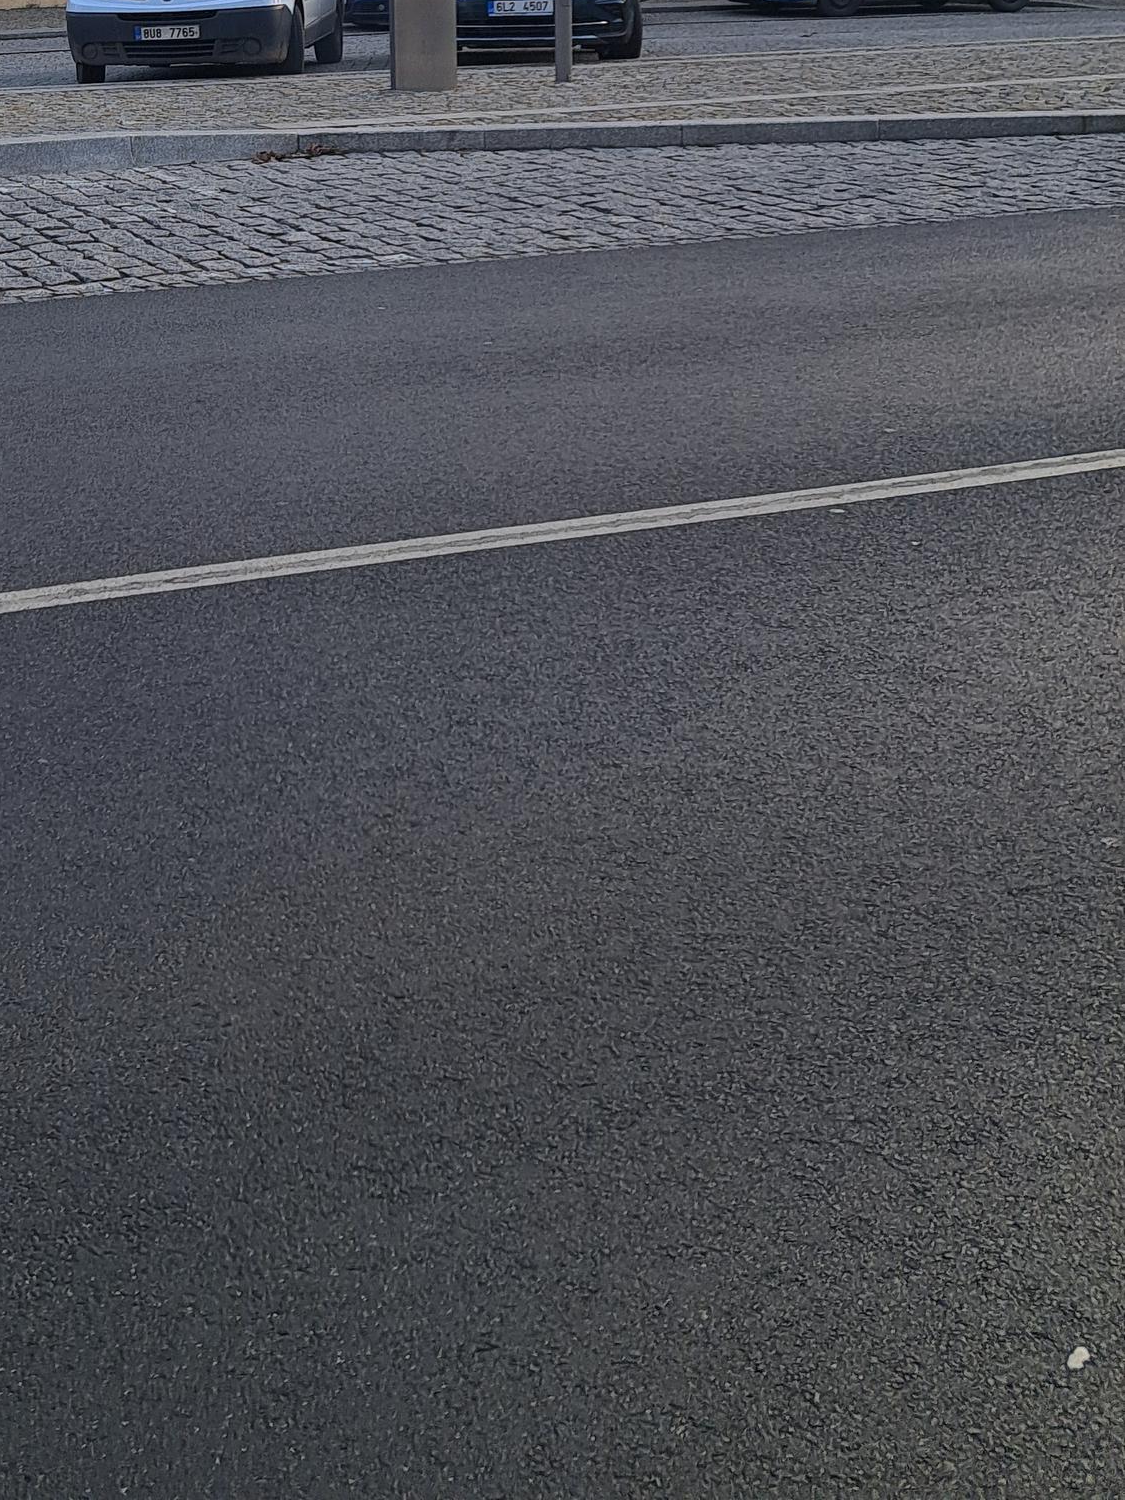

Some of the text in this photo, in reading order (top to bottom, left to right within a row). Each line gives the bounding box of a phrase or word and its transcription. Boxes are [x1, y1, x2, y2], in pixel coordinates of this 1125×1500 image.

[496, 0, 549, 12] 6L2 4507
[143, 26, 195, 39] 8U8 7765
